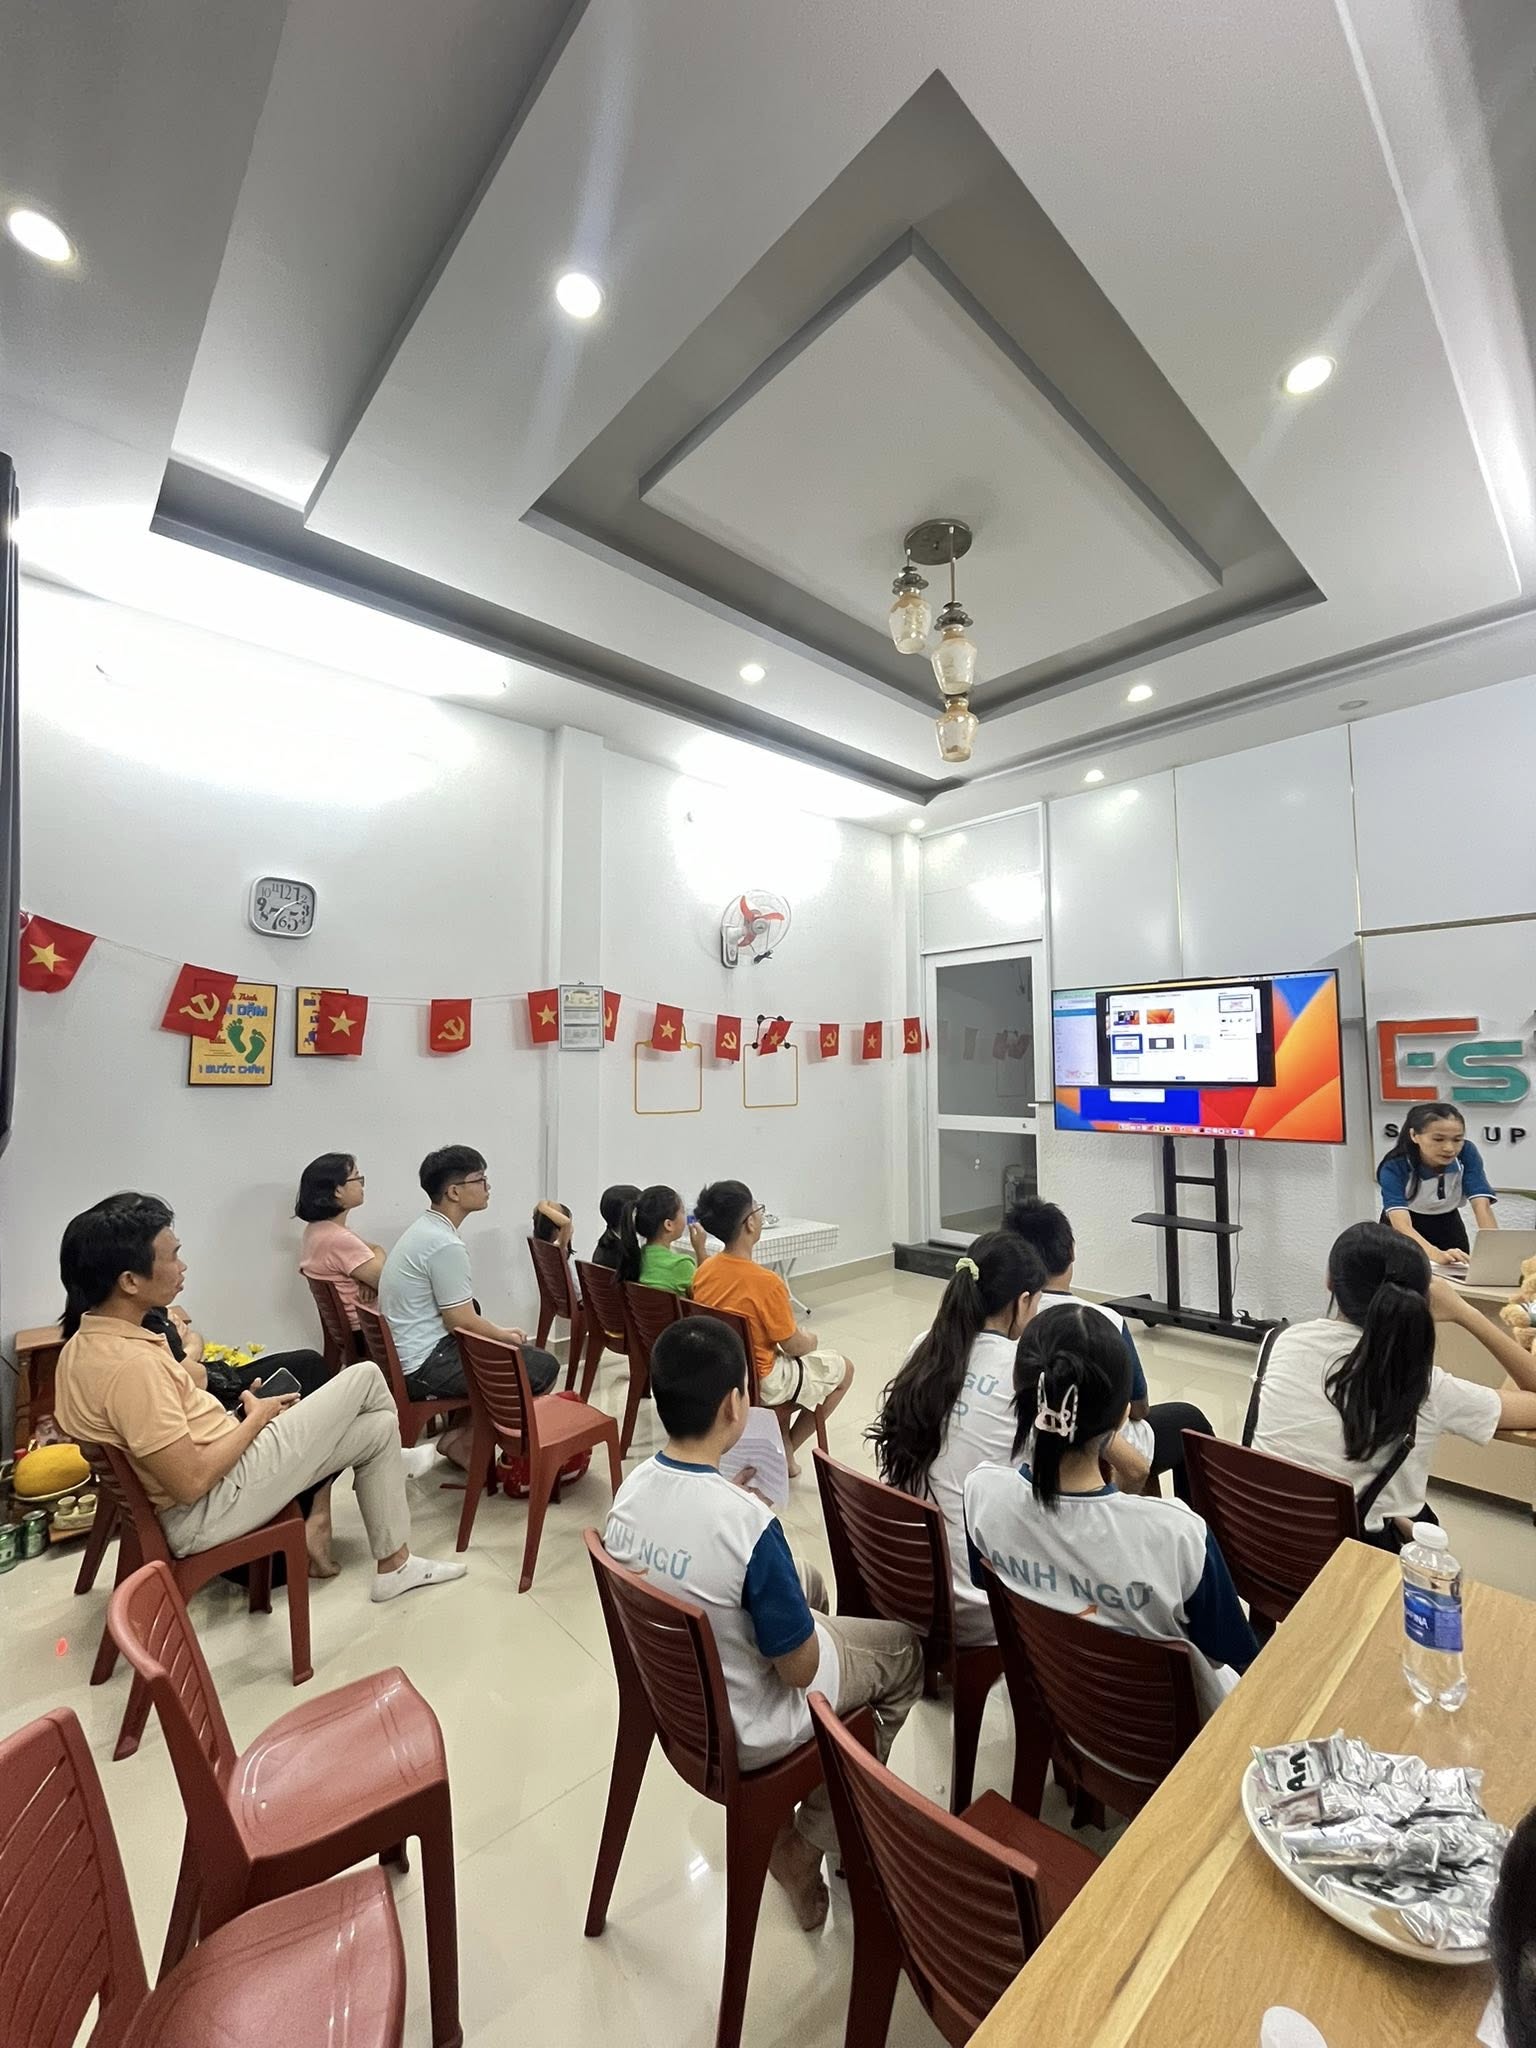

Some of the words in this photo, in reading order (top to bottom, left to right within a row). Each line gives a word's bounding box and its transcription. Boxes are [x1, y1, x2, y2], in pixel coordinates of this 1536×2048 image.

[261, 887, 271, 898] 10
[280, 884, 292, 900] 12
[257, 897, 267, 911] 9
[278, 915, 287, 928] 6
[287, 911, 299, 931] 5
[1484, 1126, 1527, 1144] UP
